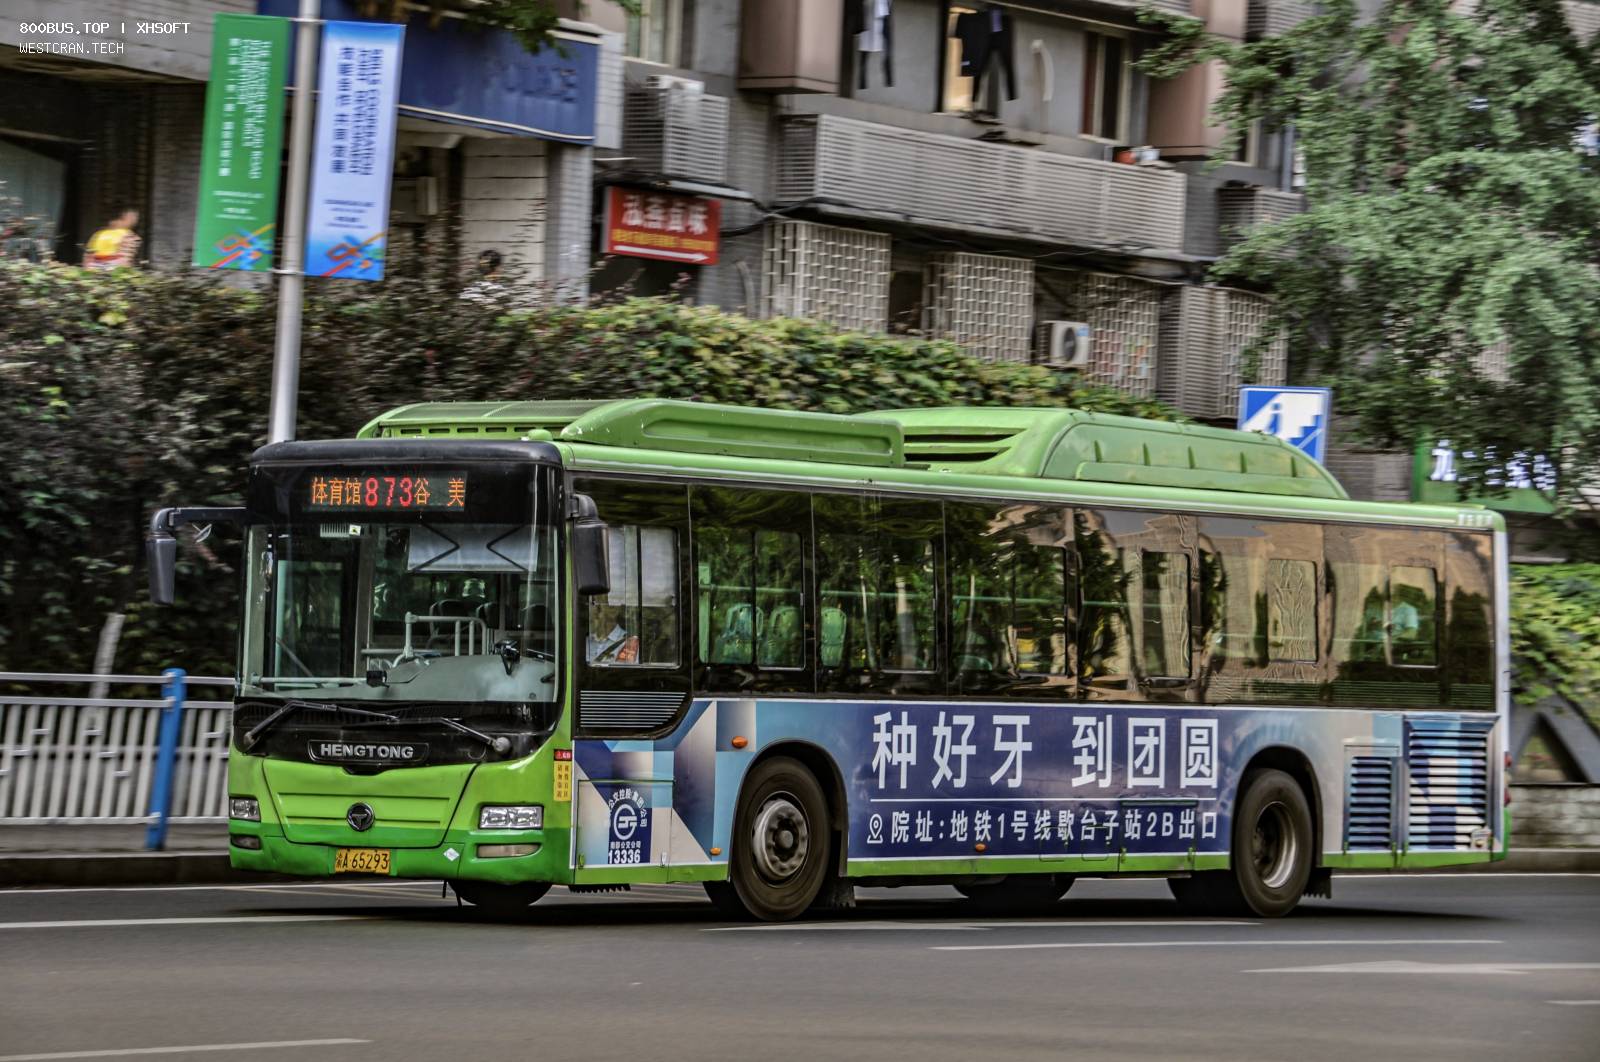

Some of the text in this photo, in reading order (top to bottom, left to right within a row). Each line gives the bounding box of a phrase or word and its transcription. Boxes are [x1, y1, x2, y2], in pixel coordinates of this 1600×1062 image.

[311, 476, 362, 506] 体育馆
[364, 476, 413, 506] 873
[320, 742, 414, 760] HENGTONG
[871, 711, 1220, 789] 种好牙 到团圆
[890, 808, 1218, 844] 院址:地铁1号线歇台子站2B出口
[608, 848, 641, 865] 13336
